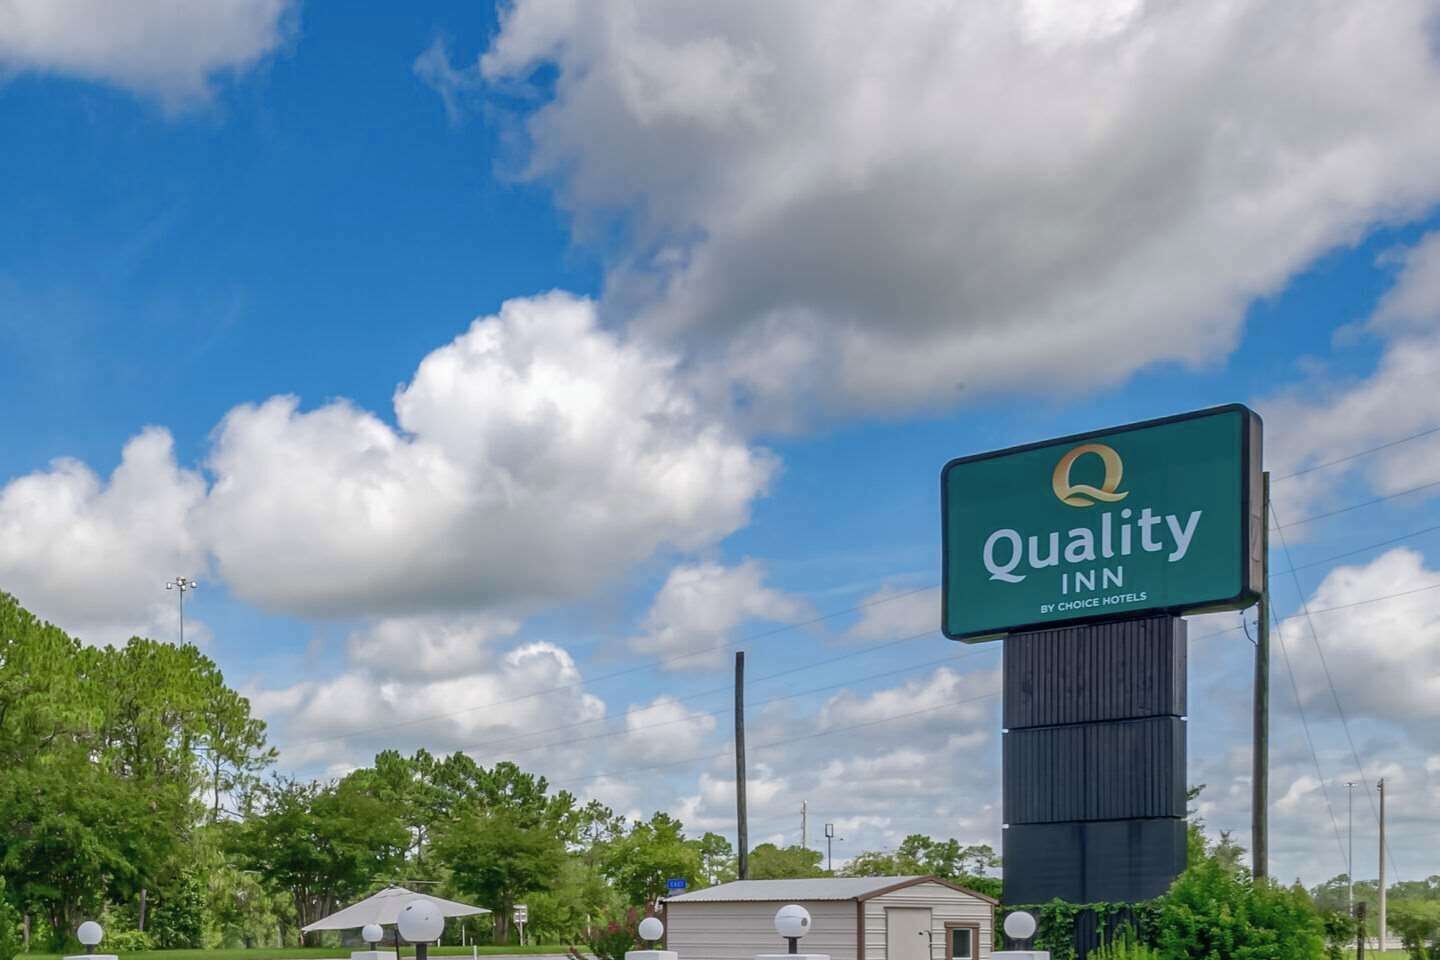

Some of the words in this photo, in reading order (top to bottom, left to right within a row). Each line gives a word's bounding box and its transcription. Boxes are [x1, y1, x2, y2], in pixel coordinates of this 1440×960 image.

[1052, 444, 1129, 507] Q
[983, 508, 1202, 583] Quality
[1062, 566, 1124, 594] INN
[1040, 604, 1057, 614] BY
[1058, 598, 1100, 612] CHOICE
[1102, 592, 1148, 606] HOTELS
